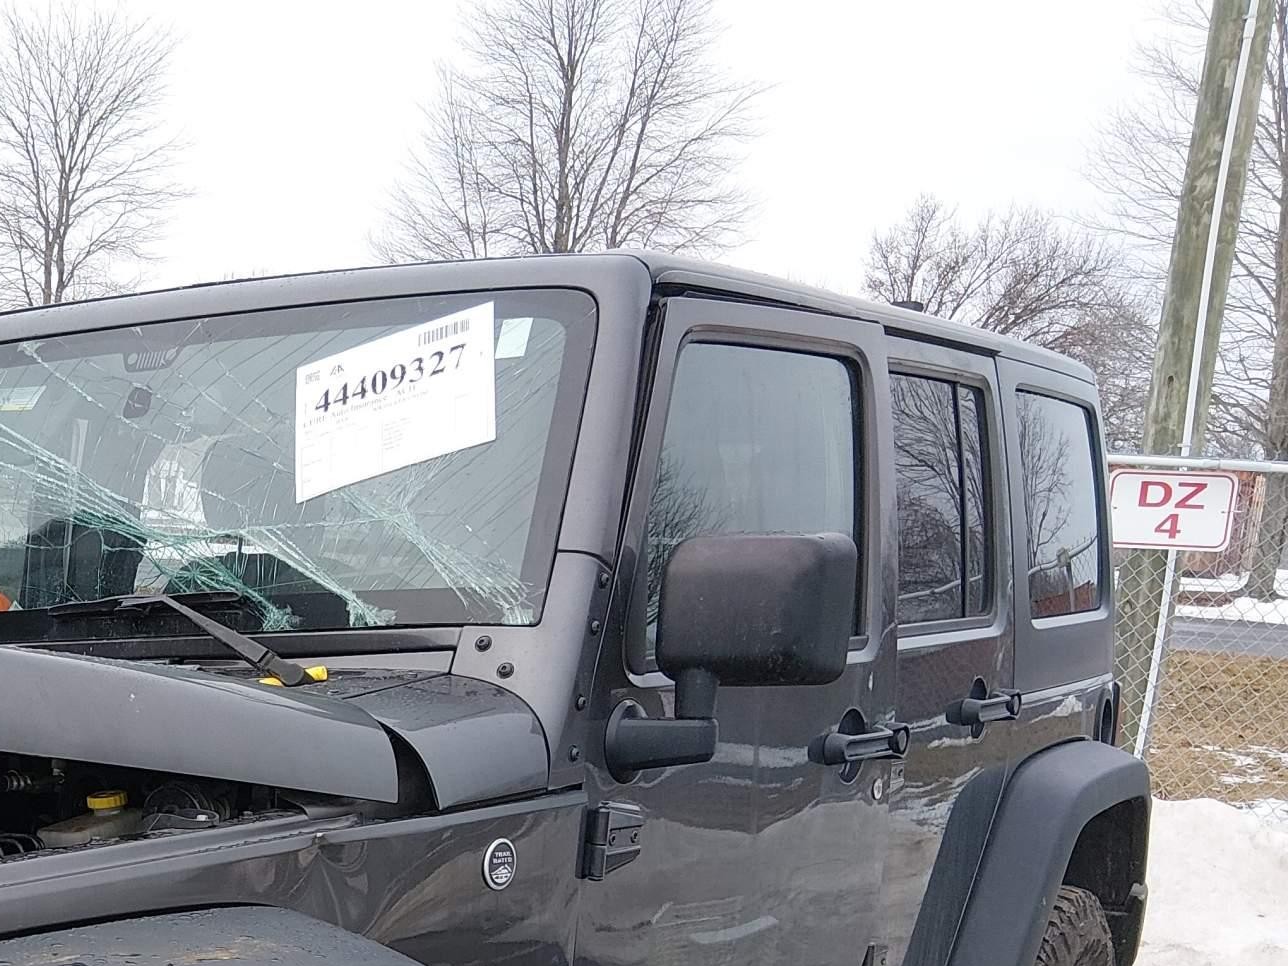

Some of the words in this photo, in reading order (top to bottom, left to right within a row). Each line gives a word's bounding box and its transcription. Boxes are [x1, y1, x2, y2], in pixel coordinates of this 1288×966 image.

[315, 343, 467, 412] 44409327
[1138, 481, 1208, 510] DZ
[1154, 513, 1182, 539] 4
